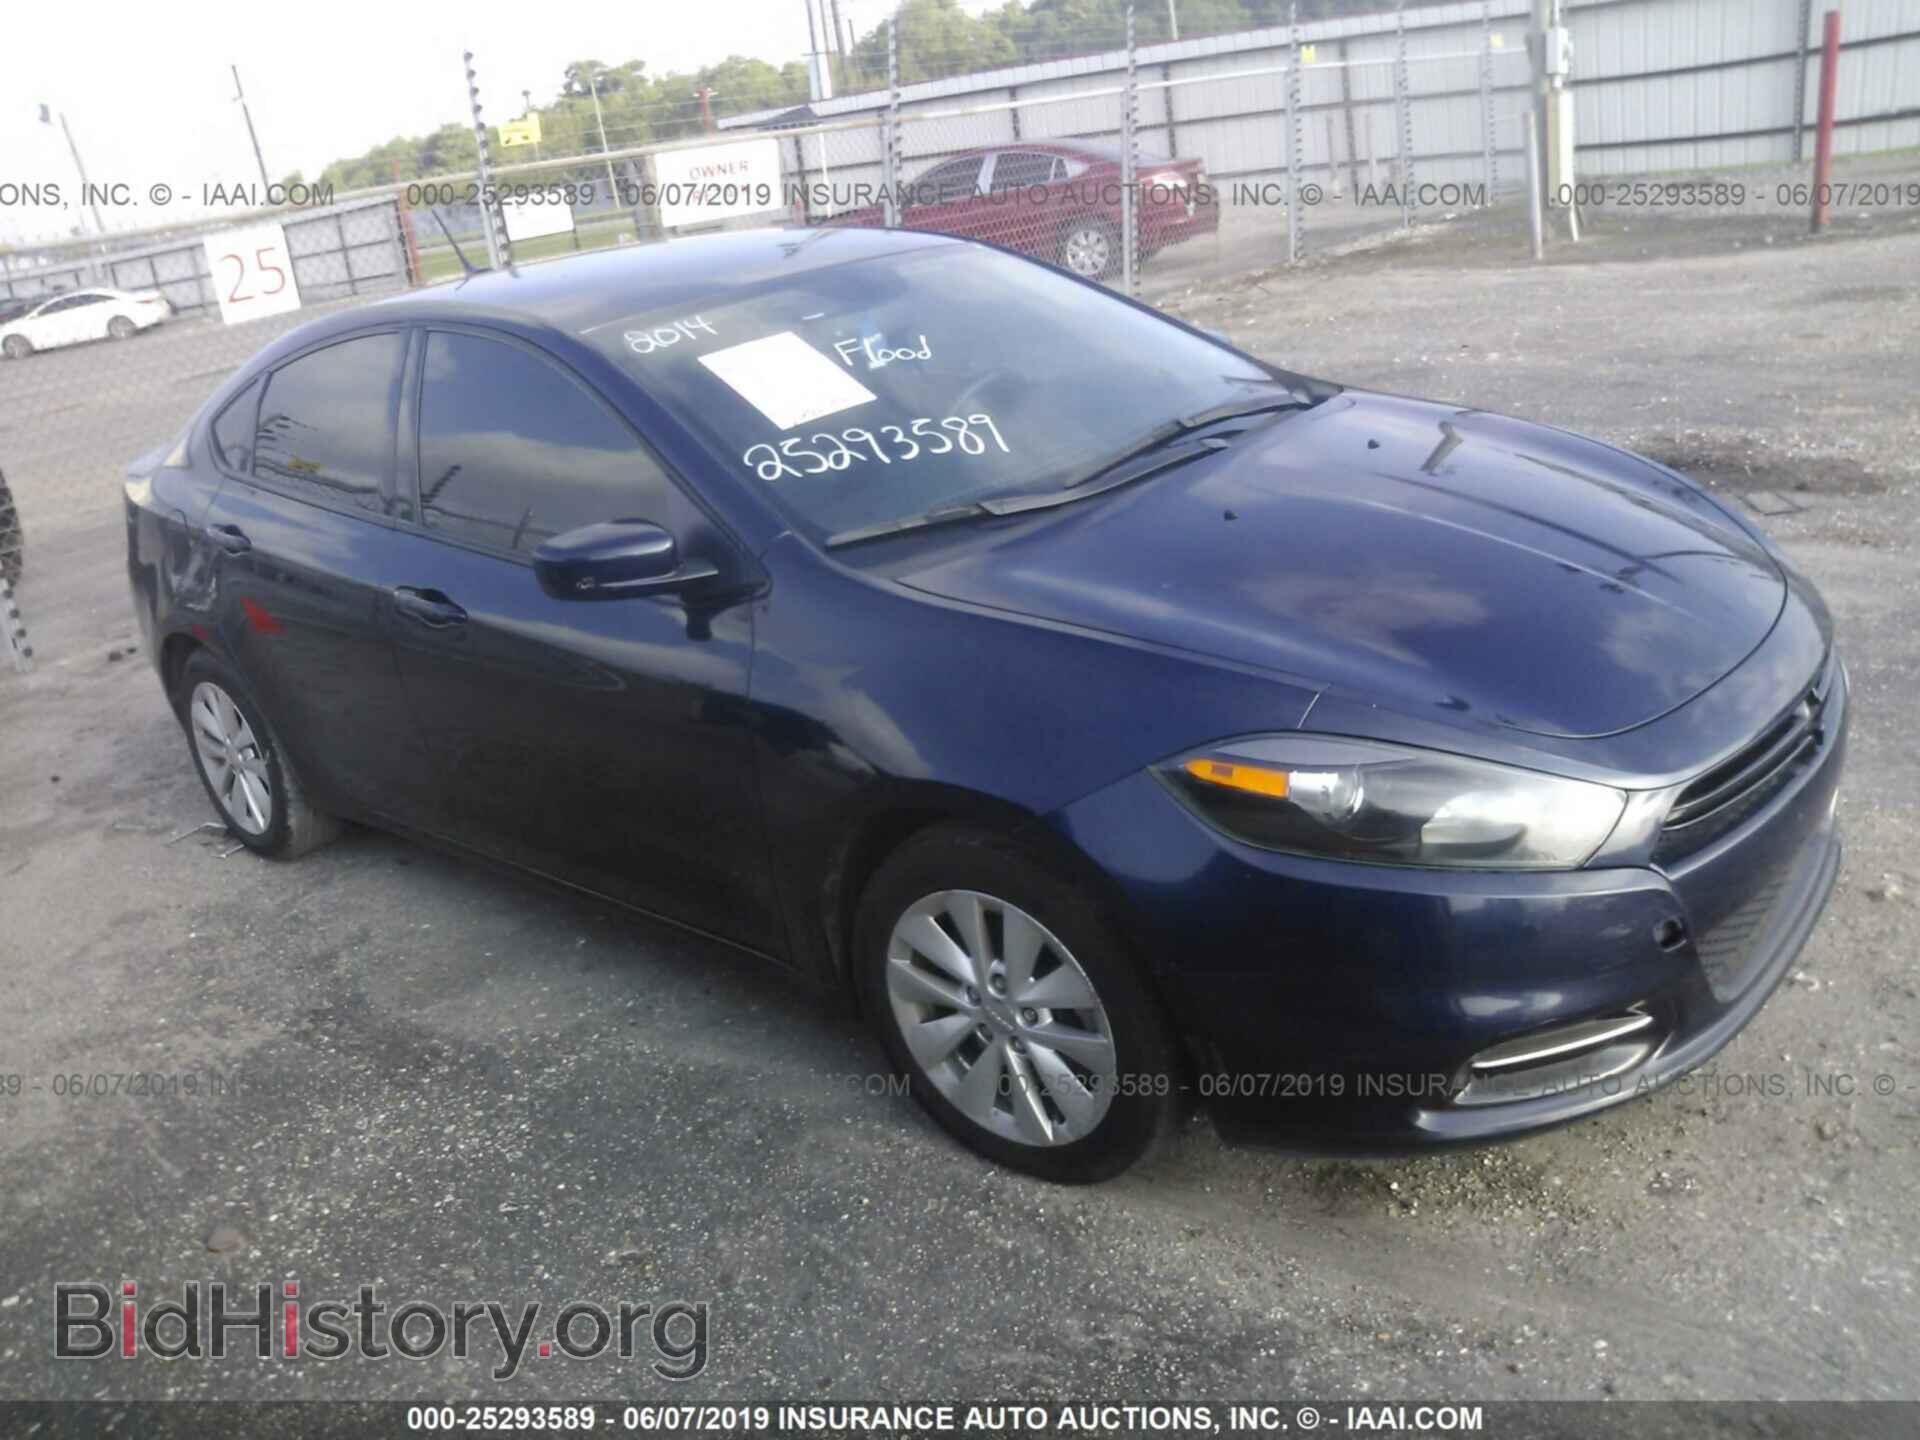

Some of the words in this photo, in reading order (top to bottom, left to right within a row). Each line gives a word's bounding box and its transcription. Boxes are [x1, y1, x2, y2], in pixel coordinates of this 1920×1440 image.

[220, 246, 287, 304] 25
[624, 314, 718, 354] 2014
[833, 333, 932, 370] Flood
[743, 413, 1011, 481] 25293589
